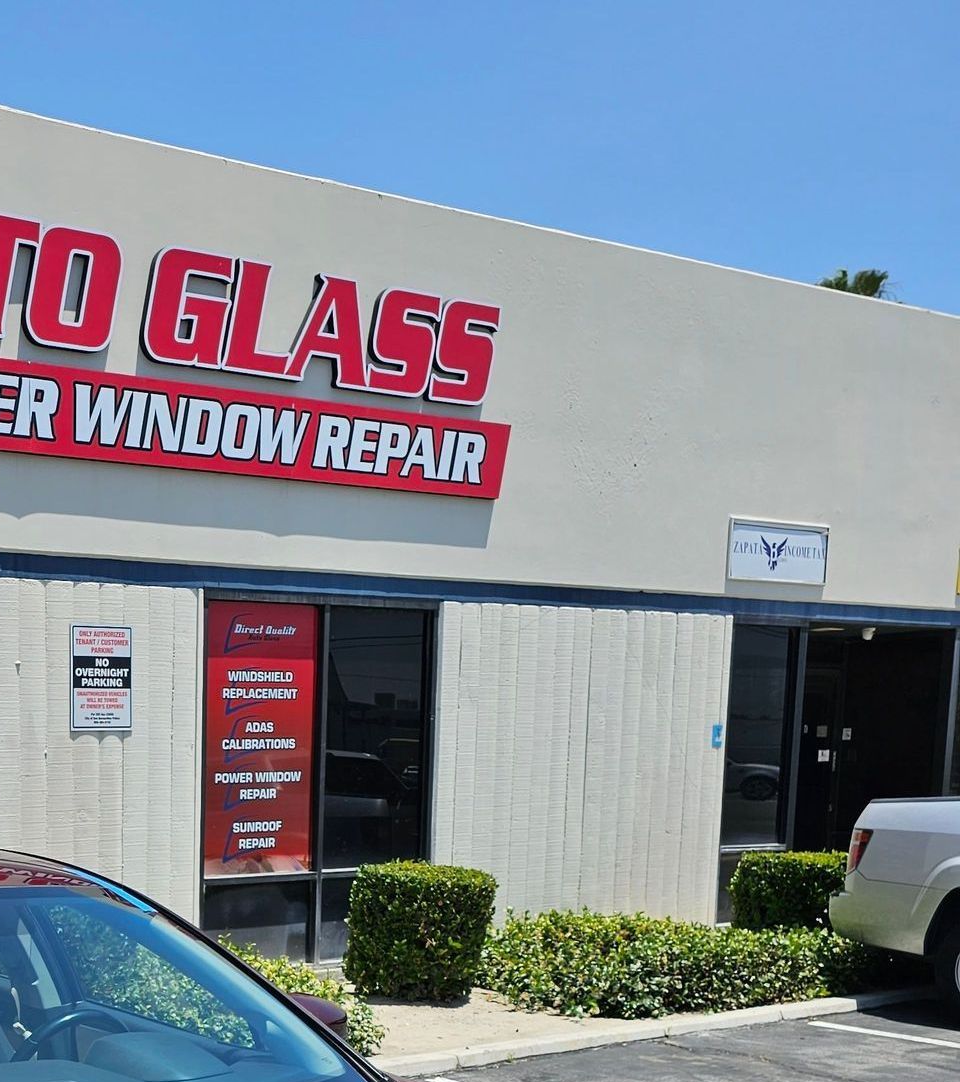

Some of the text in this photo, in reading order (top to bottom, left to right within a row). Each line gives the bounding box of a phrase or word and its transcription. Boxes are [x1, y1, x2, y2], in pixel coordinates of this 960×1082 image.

[140, 245, 502, 406] GLASS
[73, 382, 312, 465] WINDOW
[312, 413, 487, 485] REPAIR
[733, 541, 763, 556] ZAPATA
[784, 545, 810, 559] INCOME
[234, 624, 297, 636] Direct Quality
[95, 658, 110, 667] NO
[75, 667, 130, 678] OVERNIGHT
[227, 670, 294, 682] WINDSHIELD
[81, 678, 123, 687] PARKING
[222, 688, 299, 699] REPLACEMENT
[245, 722, 274, 733] ADAS
[222, 739, 296, 750] CALIBRATIONS
[214, 771, 302, 784] POWER WINDOW
[239, 788, 277, 800] REPAIR
[232, 821, 283, 833] SUNROOF
[238, 837, 276, 849] REPAIR
